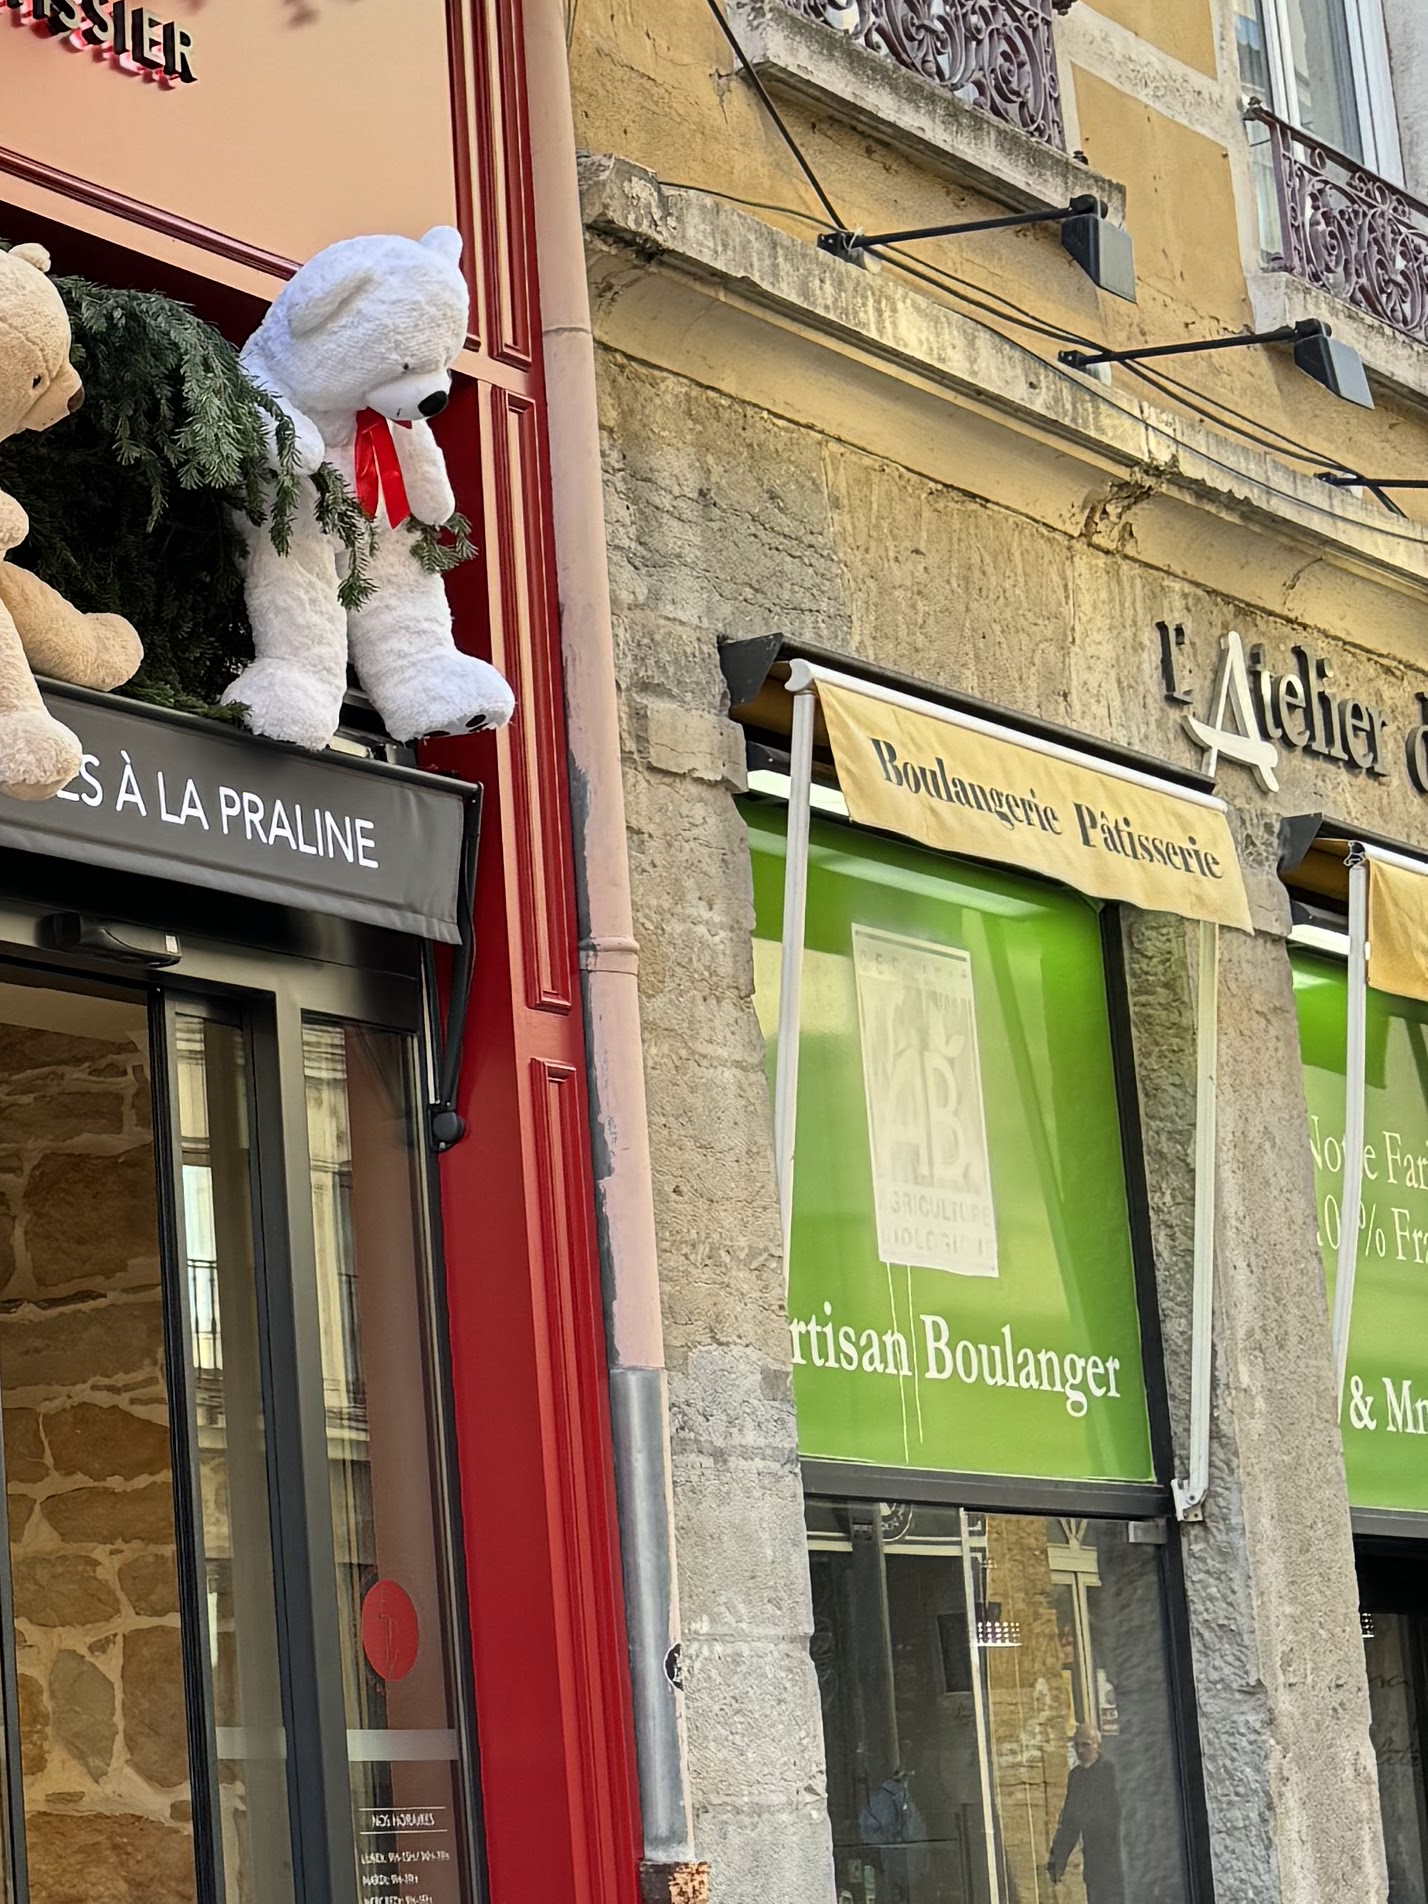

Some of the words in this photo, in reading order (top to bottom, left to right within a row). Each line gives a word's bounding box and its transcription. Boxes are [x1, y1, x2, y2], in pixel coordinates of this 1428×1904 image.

[115, 749, 147, 817] À
[157, 770, 210, 831] LA
[219, 785, 380, 870] PRALINE
[870, 737, 1064, 836] Boulangerie
[1072, 800, 1225, 880] Pâtisserie
[787, 1300, 913, 1377] rtisan
[919, 1314, 1122, 1418] Boulanger
